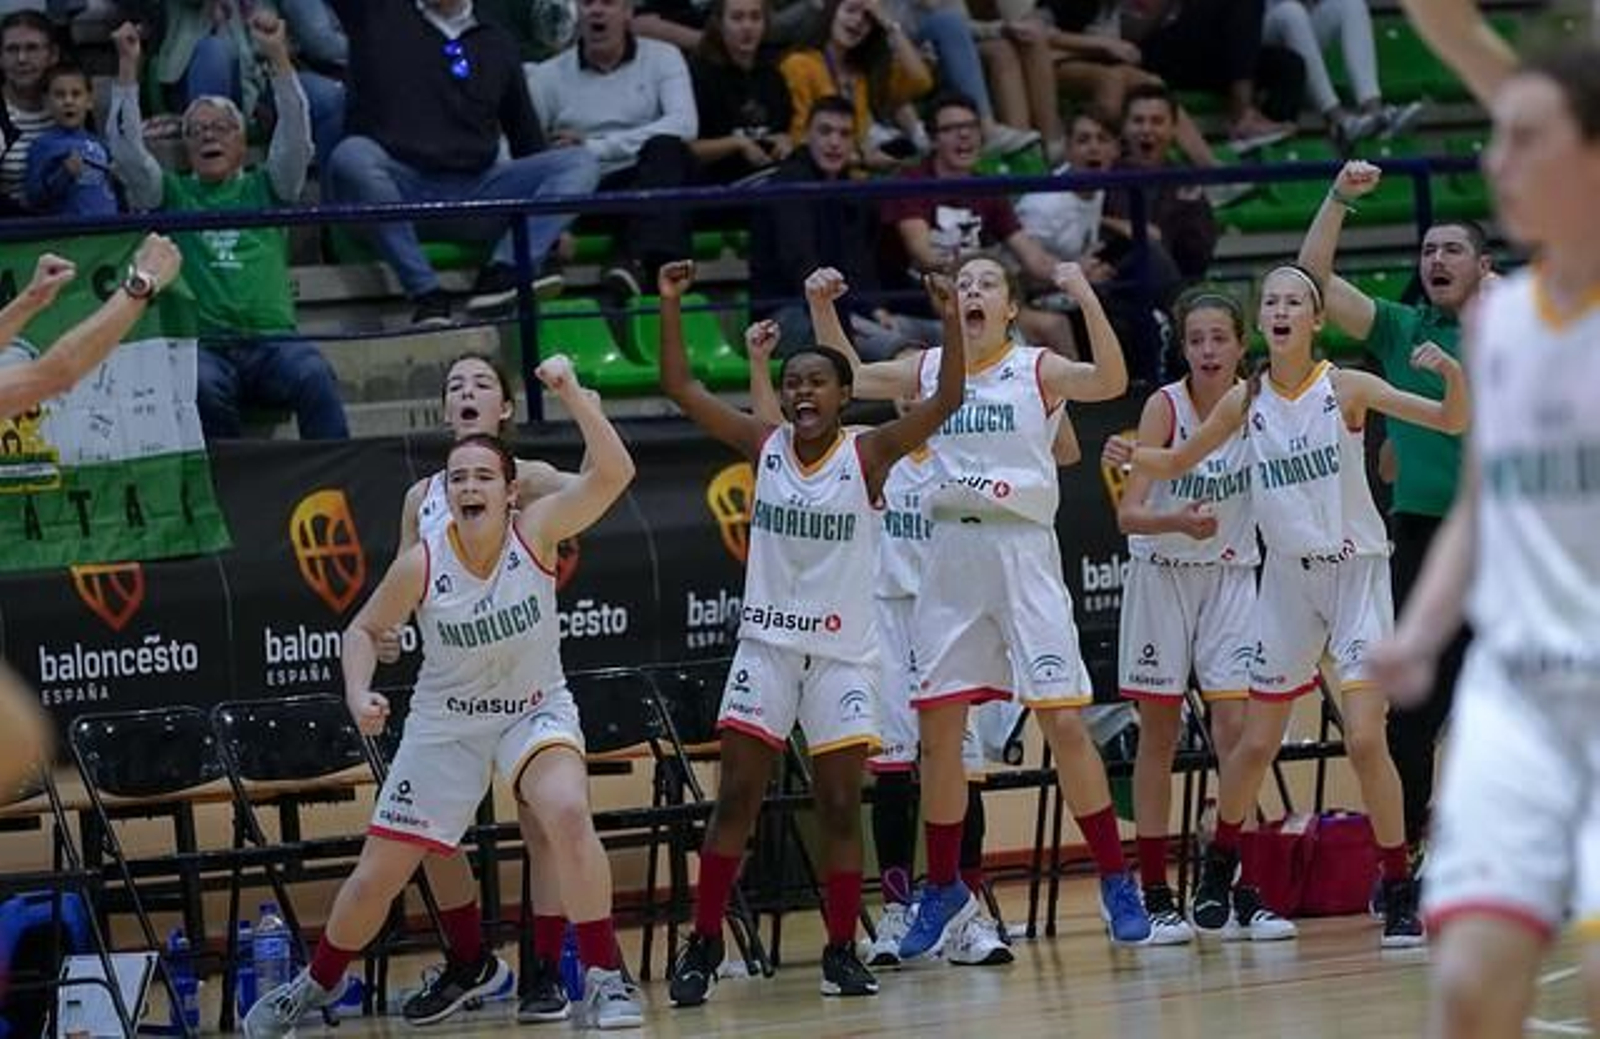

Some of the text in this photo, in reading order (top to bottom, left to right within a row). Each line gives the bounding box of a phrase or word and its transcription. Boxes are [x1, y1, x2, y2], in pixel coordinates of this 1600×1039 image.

[942, 404, 1015, 436] DALUCIA
[437, 594, 541, 649] ANDALUCIA
[558, 599, 628, 639] cesto
[742, 604, 822, 632] cajasur
[41, 684, 109, 706] ESPAÑA
[446, 697, 528, 716] cajasur
